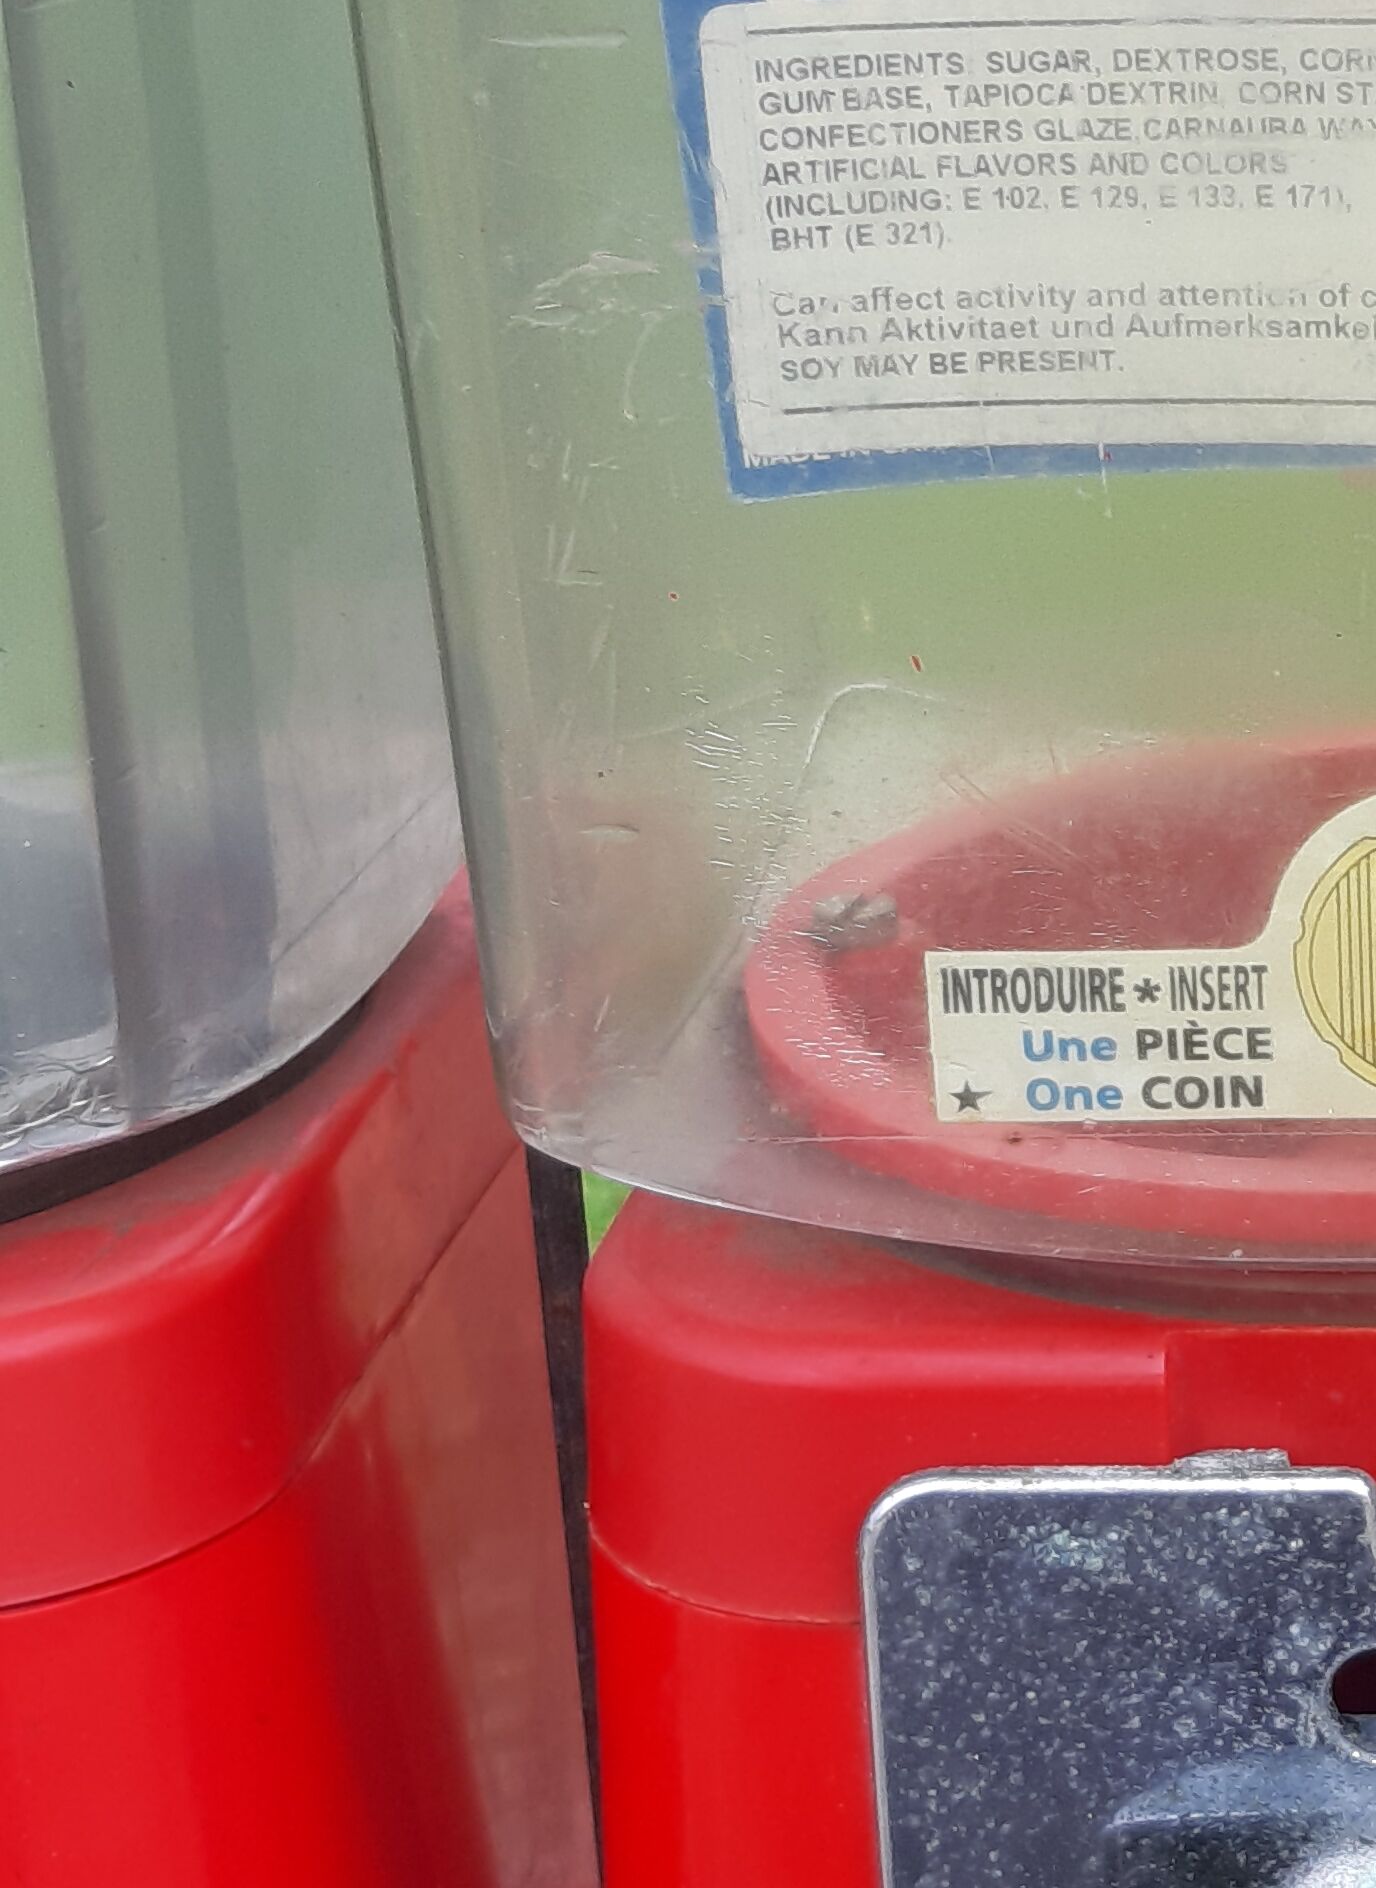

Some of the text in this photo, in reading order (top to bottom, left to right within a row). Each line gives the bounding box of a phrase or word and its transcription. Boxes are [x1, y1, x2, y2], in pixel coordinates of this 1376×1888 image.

[986, 49, 1100, 77] SUGAR,
[1113, 47, 1287, 76] DEXTROSE,
[758, 88, 835, 115] GUM
[843, 85, 932, 113] BASE,
[944, 82, 1074, 108] TAPIOCA
[1239, 80, 1325, 105] CORN
[759, 118, 1023, 151] CONFECTIONERS
[762, 155, 926, 186] ARTIFICIAL
[937, 153, 1076, 178] FLAVORS
[1089, 152, 1149, 176] AND
[765, 188, 951, 225] (INCLUDING:
[963, 187, 981, 210] E
[1060, 185, 1080, 209] E
[1159, 185, 1177, 208] E
[1255, 184, 1274, 209] E
[770, 224, 834, 252] BHT
[846, 224, 876, 254] (E
[850, 285, 946, 313] affect
[956, 282, 1076, 314] activity
[1087, 281, 1146, 307] and
[1318, 282, 1352, 308] of
[777, 322, 868, 348] Kann
[880, 315, 1040, 343] Aktivitaet
[1052, 314, 1114, 338] und
[780, 349, 1125, 382] SOY MAY BE PRESENT.
[939, 964, 1270, 1016] INTRODUIRE INSERT
[1022, 1021, 1273, 1064] Une PIÈCE
[1025, 1074, 1264, 1113] One COIN
